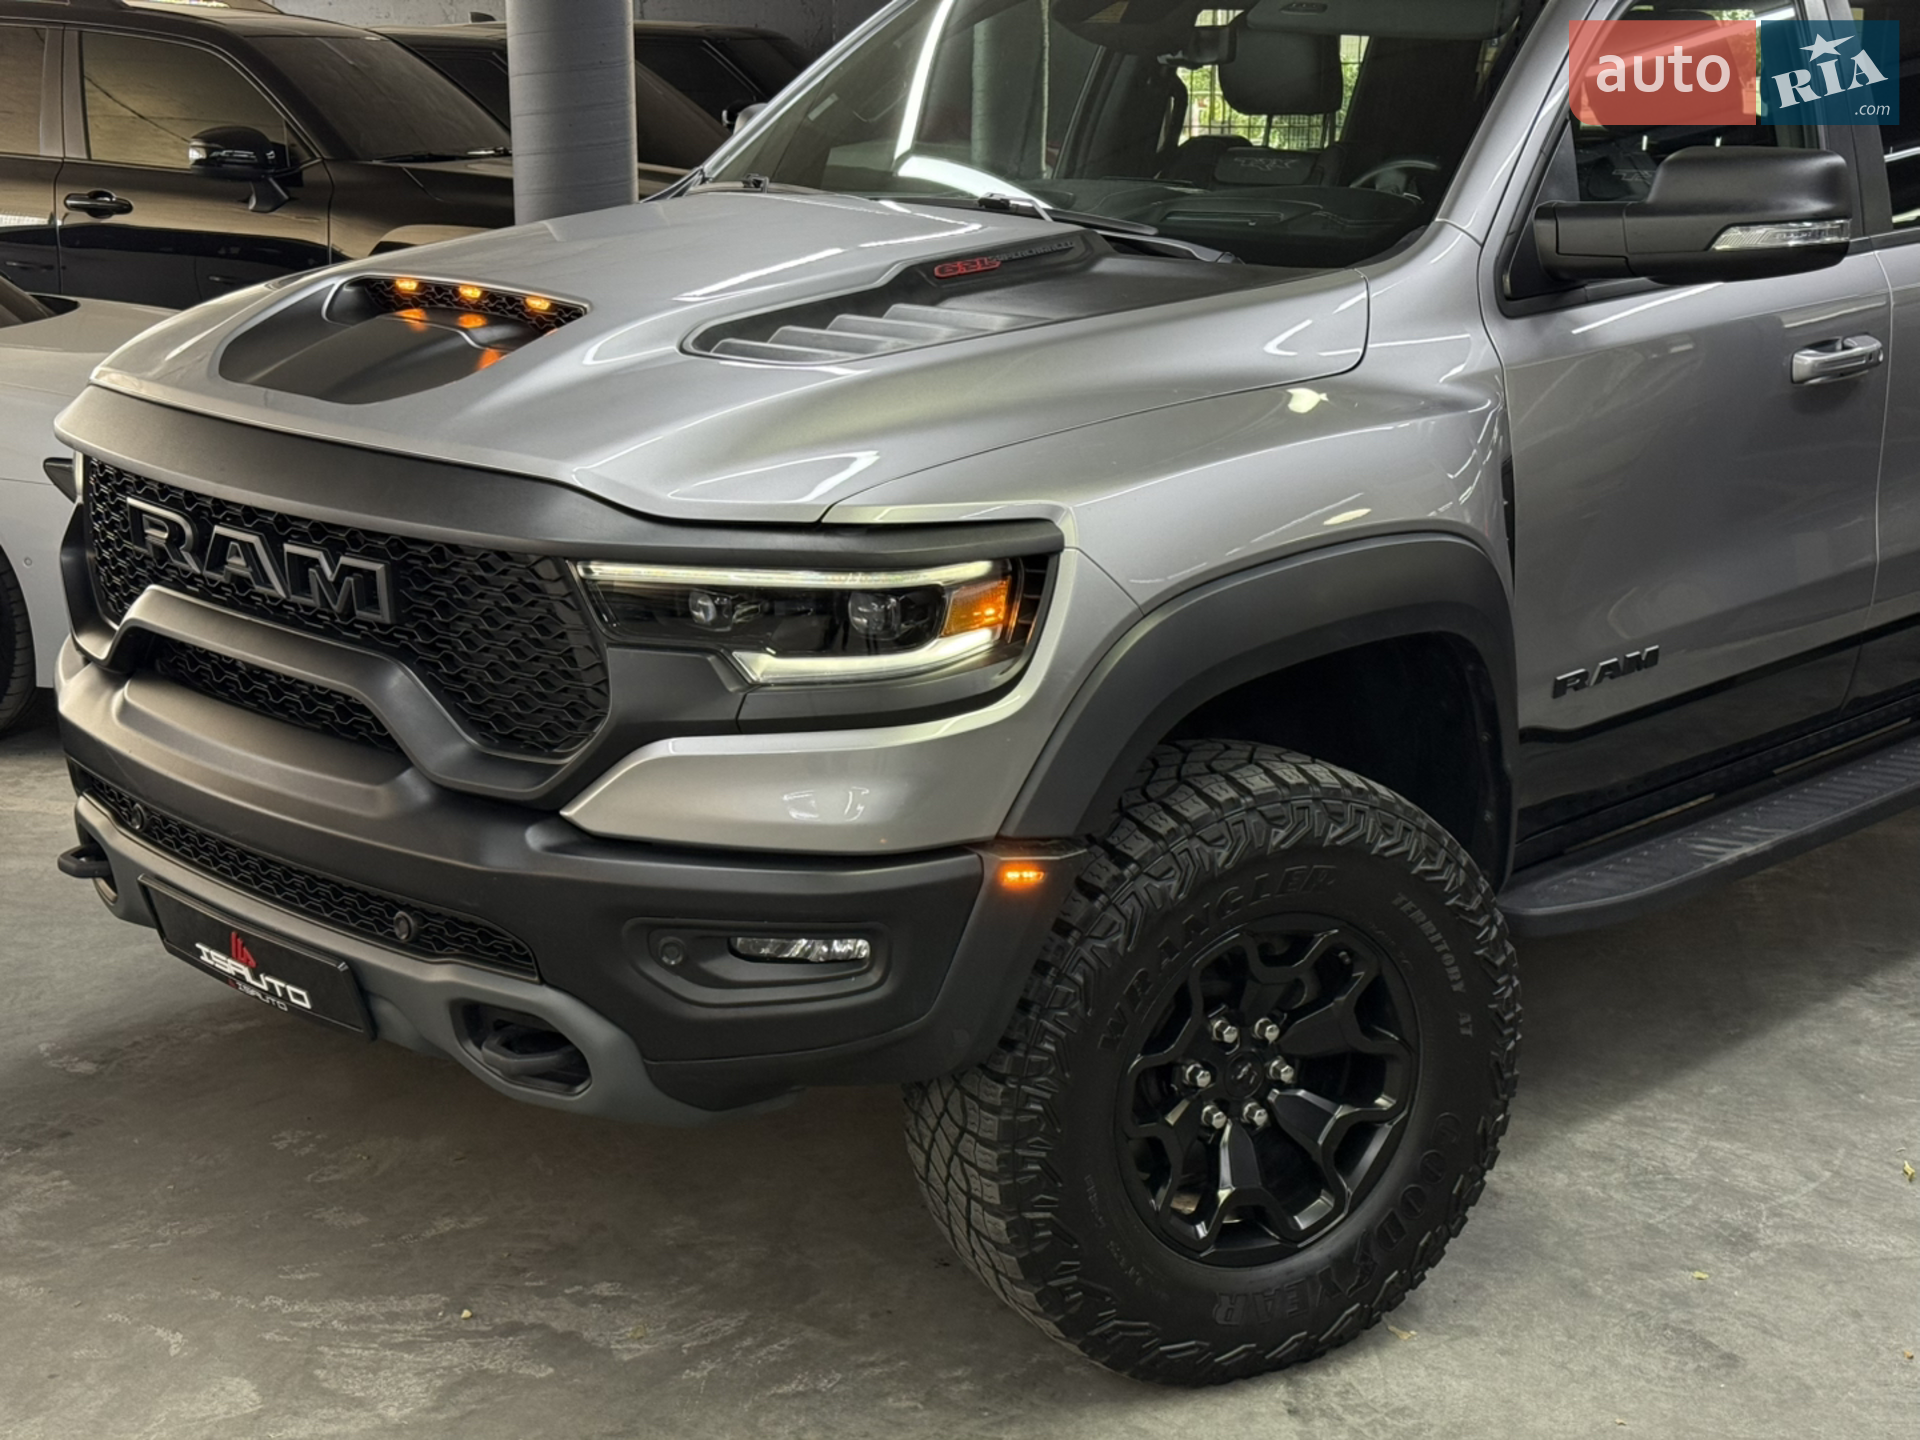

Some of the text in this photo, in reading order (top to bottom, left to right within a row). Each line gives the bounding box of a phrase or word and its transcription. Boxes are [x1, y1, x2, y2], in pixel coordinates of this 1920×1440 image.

[126, 496, 396, 623] RAM
[1551, 645, 1659, 699] RAM
[195, 942, 312, 1009] ISAUTO
[1098, 865, 1337, 1050] WRANGLER
[1392, 893, 1466, 993] TERRITORY
[1212, 1112, 1461, 1326] GOODYEAR
